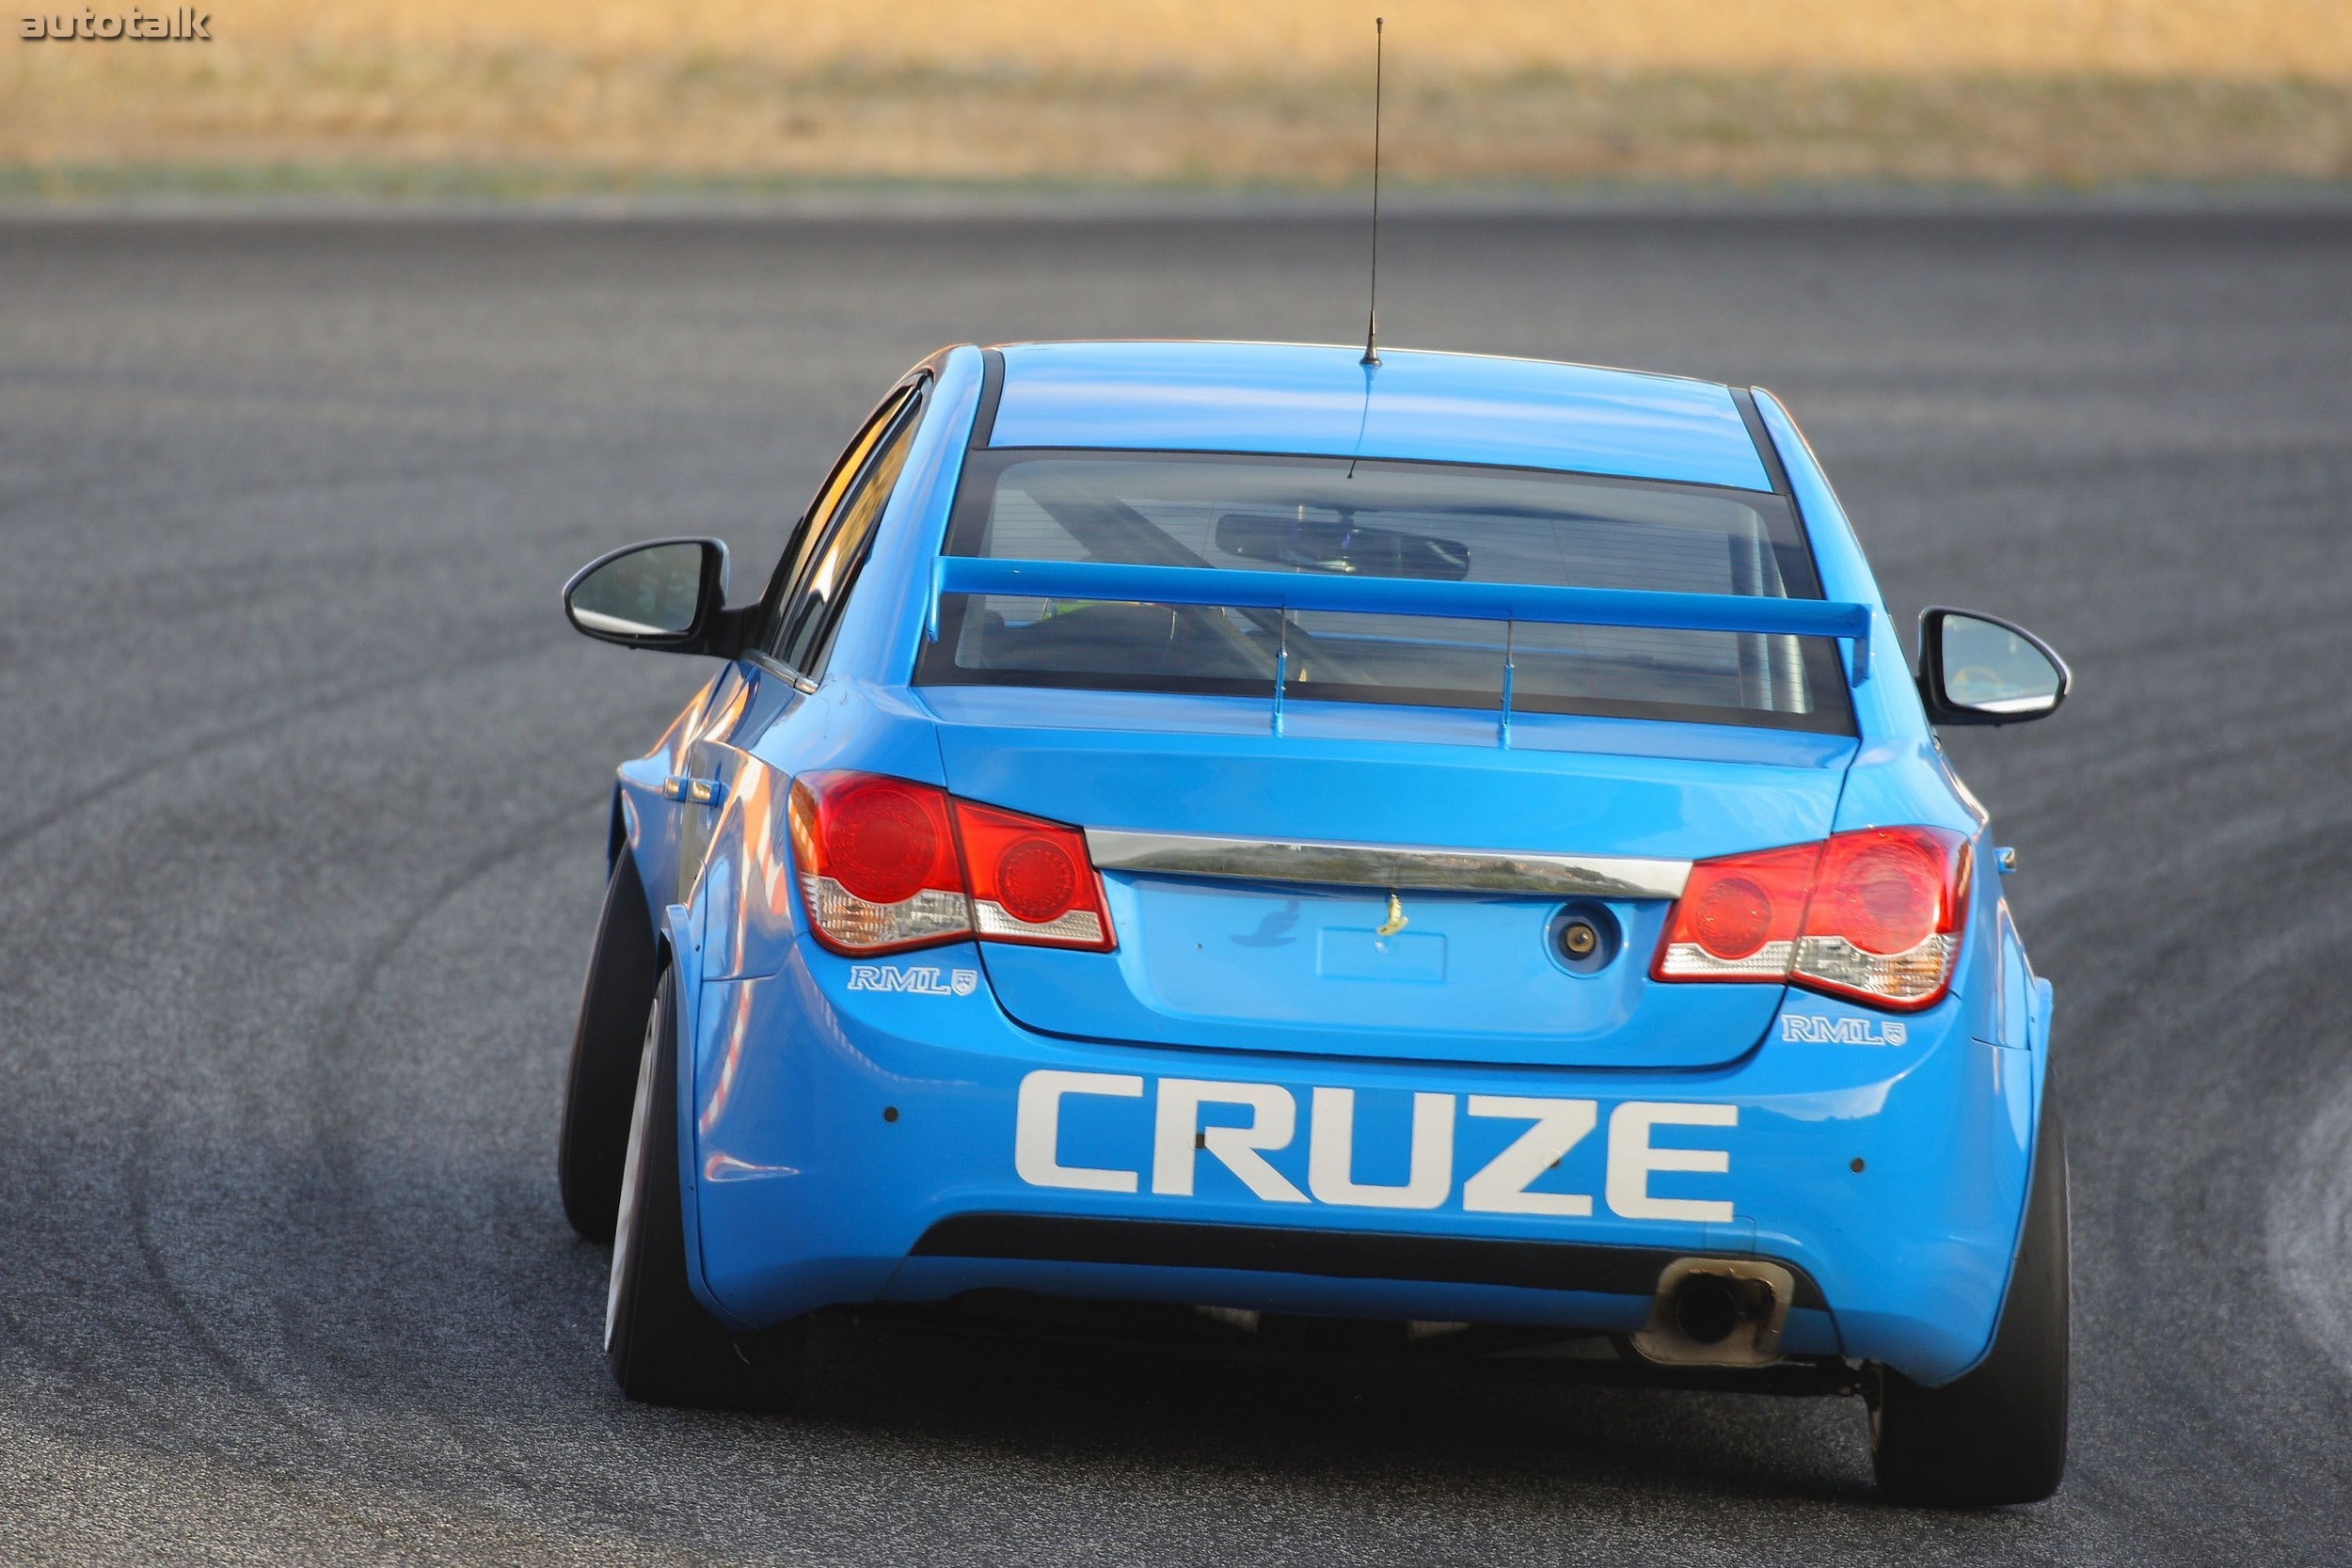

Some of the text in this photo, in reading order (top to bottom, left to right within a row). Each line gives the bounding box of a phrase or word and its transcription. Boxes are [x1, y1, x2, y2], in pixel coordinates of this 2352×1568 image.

[848, 966, 951, 995] RML
[1781, 1014, 1885, 1046] RML
[1014, 1069, 1738, 1222] CRUZE
